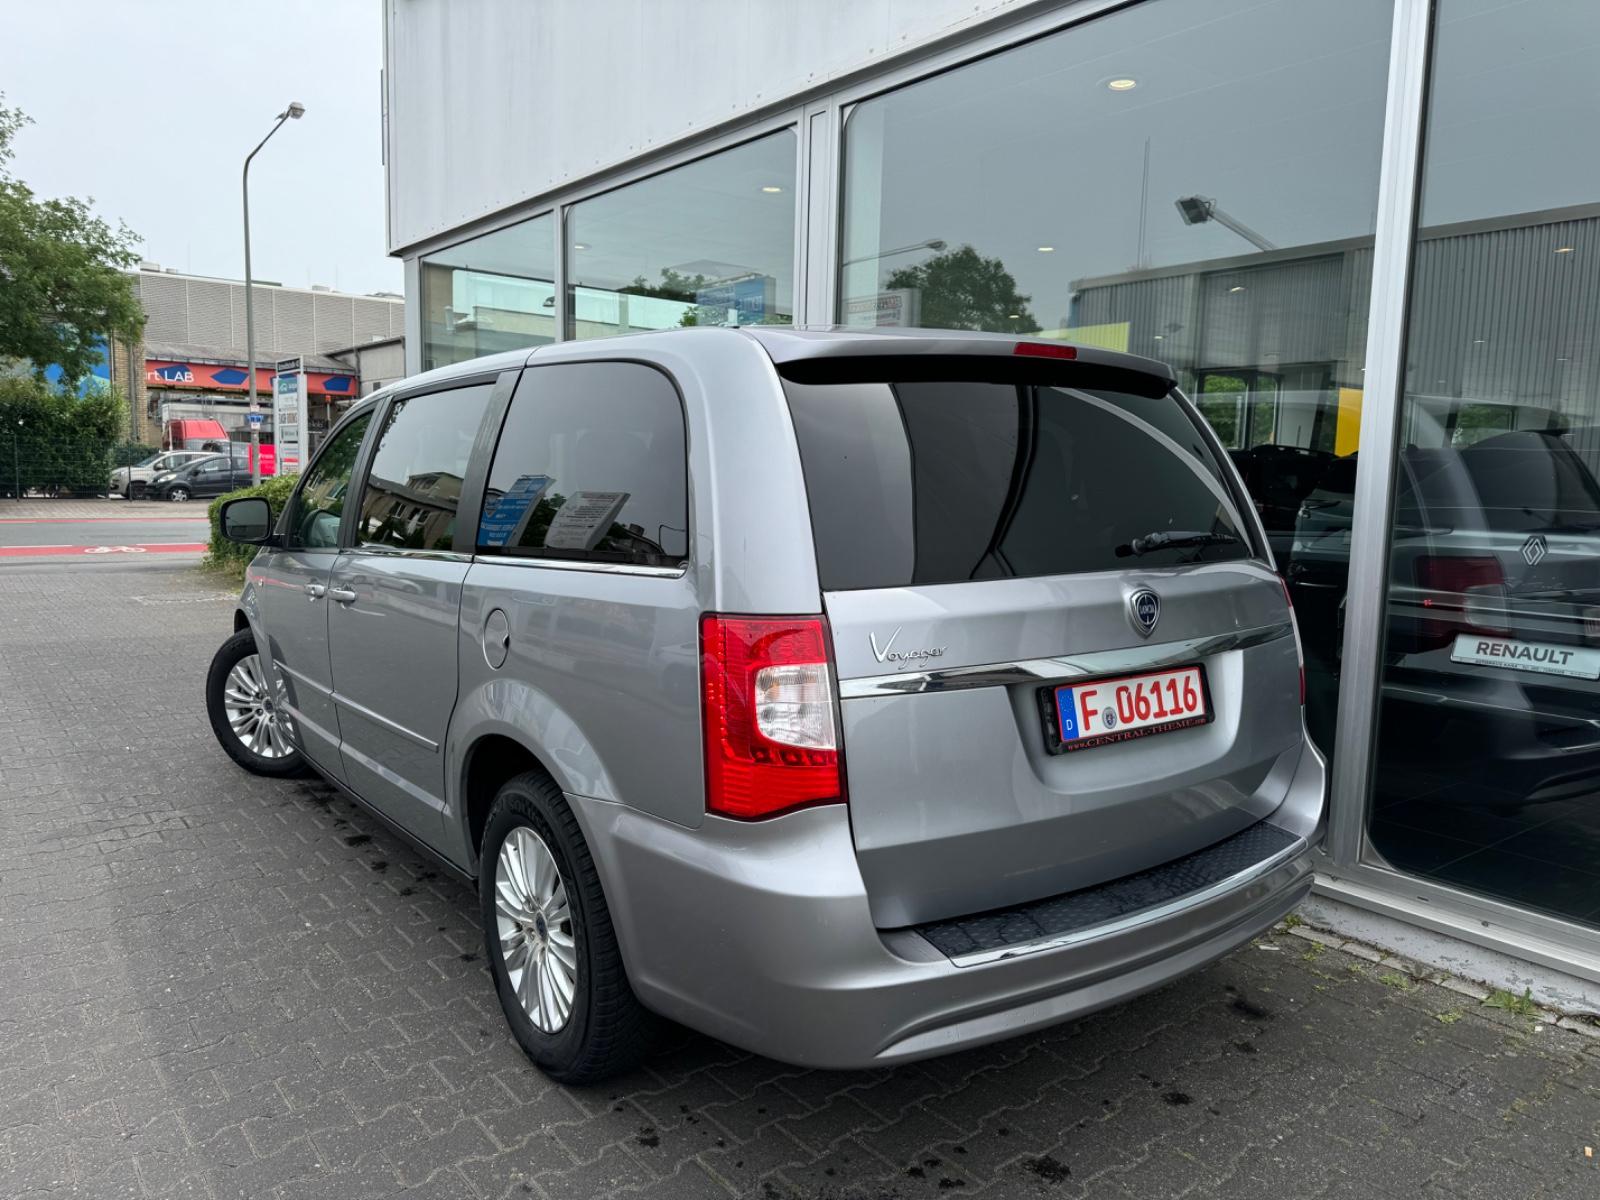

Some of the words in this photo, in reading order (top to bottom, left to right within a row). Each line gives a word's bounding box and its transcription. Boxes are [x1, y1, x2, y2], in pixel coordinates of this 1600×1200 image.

[164, 370, 195, 383] LAB
[869, 626, 949, 670] Voyager
[1476, 641, 1575, 666] RENAULT
[1079, 690, 1098, 731] F
[1115, 675, 1198, 725] 06116
[1066, 719, 1073, 731] D
